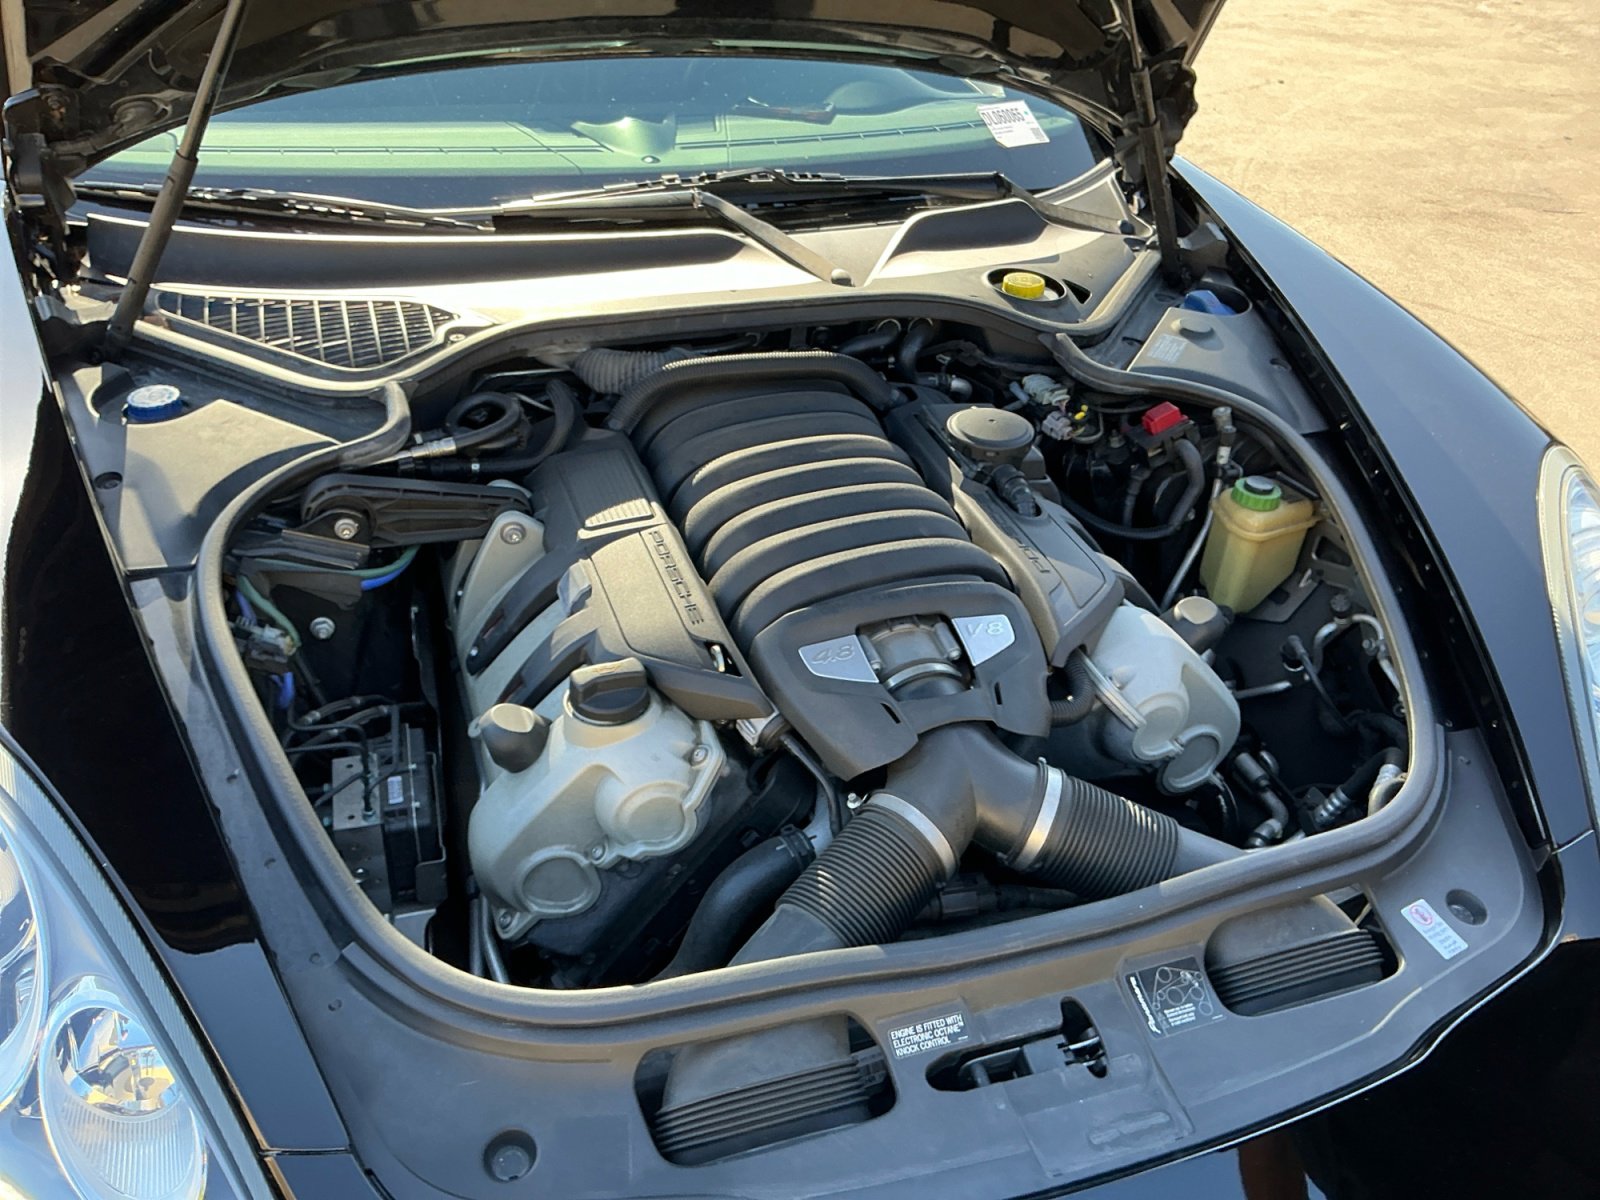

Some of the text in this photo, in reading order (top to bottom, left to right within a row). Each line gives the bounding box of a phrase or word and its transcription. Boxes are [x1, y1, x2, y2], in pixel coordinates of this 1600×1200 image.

[648, 531, 704, 625] PORSCHE
[964, 621, 1004, 637] V8
[812, 644, 855, 664] 4.8
[891, 1014, 963, 1039] ENGINE IS FITTED WITH
[893, 1031, 934, 1048] ELECTRONIC
[896, 1044, 920, 1057] KNOCK
[920, 1036, 951, 1050] CONTROL
